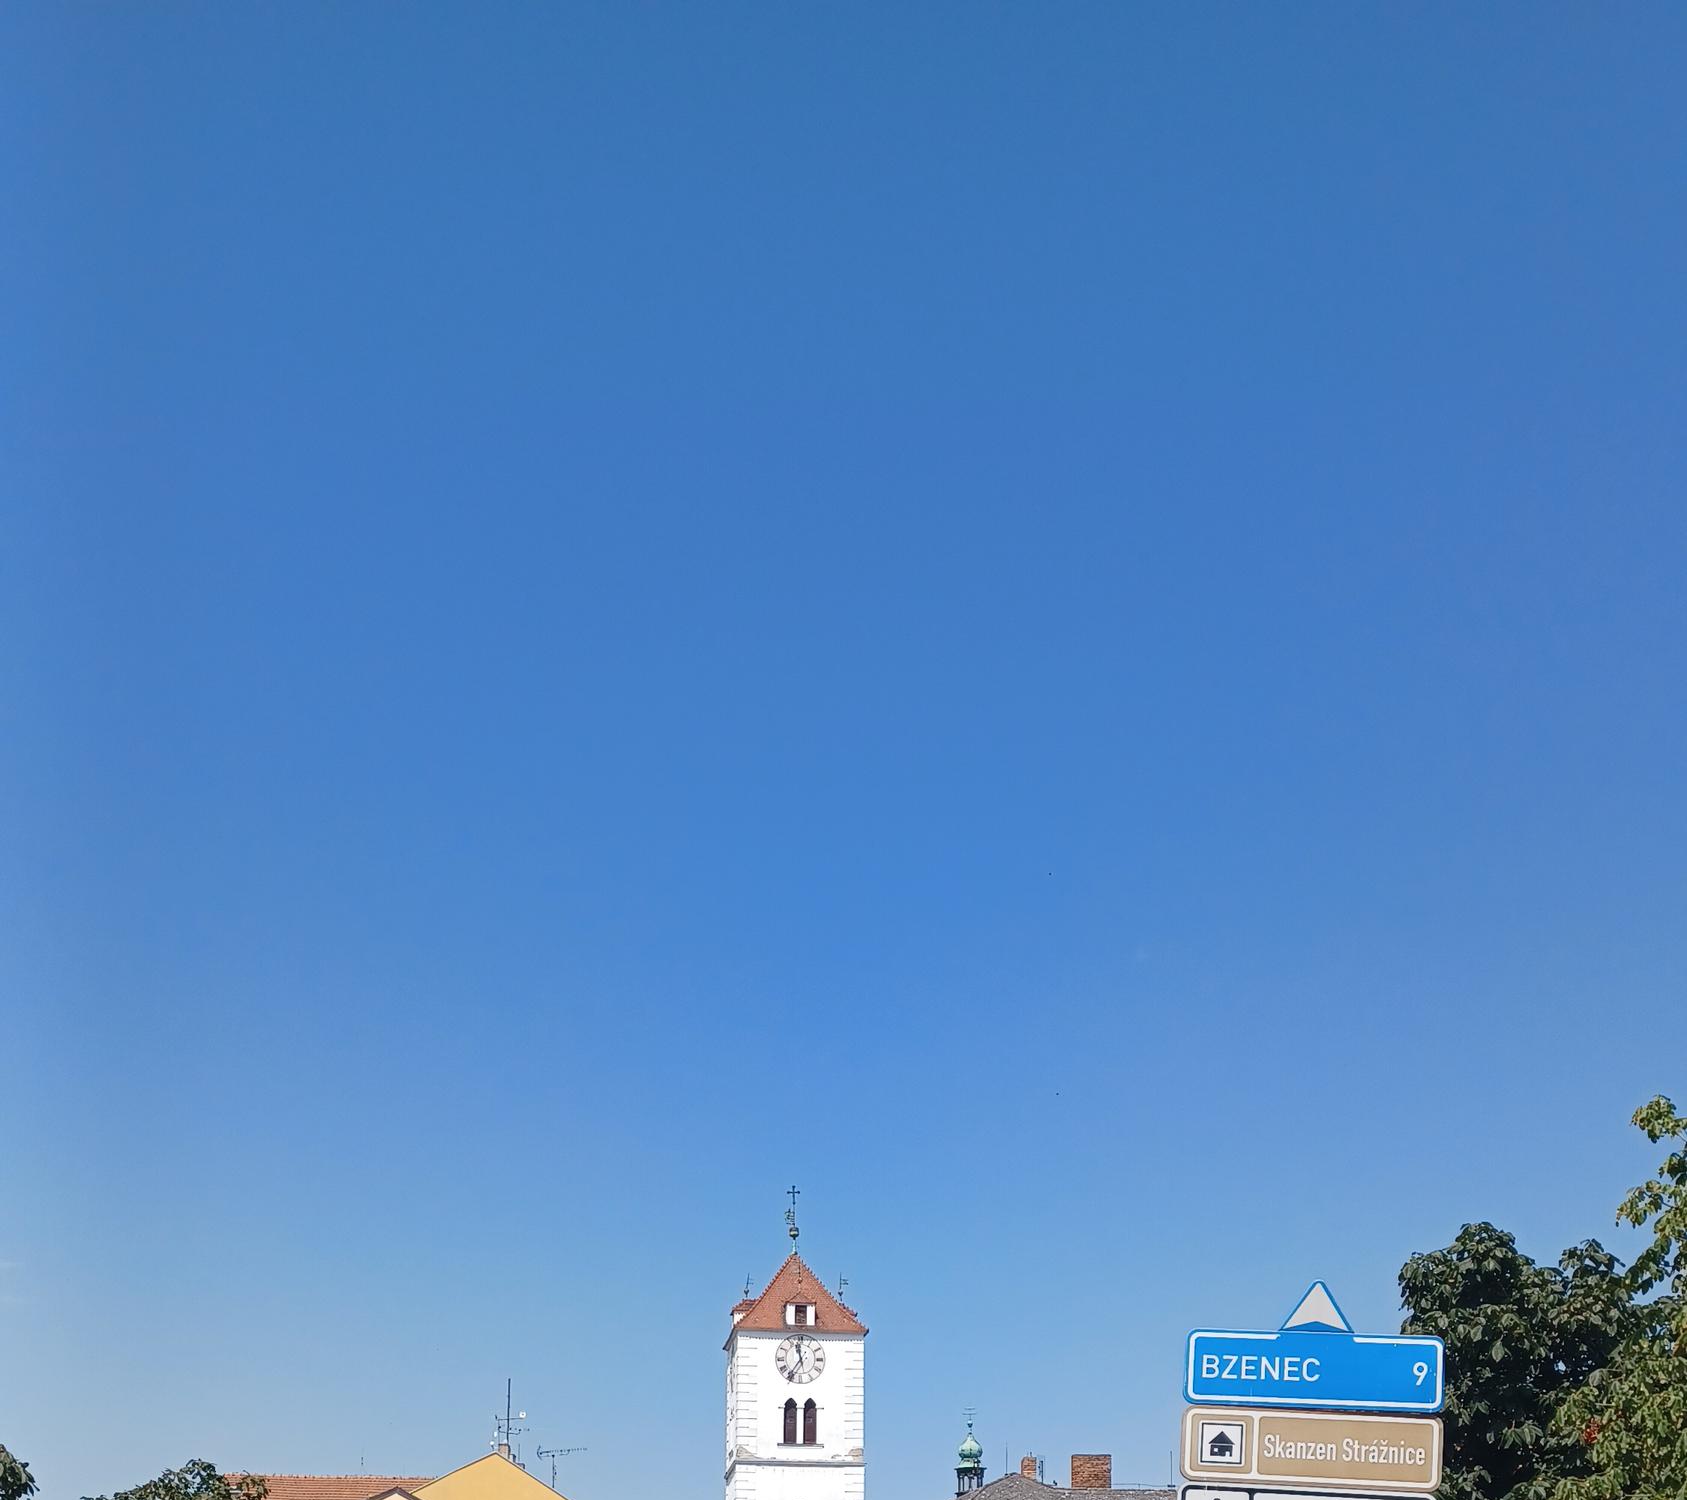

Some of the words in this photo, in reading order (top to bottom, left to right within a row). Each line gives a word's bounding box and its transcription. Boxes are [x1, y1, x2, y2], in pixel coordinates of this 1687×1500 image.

[1201, 1353, 1321, 1382] BZENEC
[1412, 1361, 1429, 1386] 9
[1263, 1433, 1337, 1462] Skanzen
[1342, 1437, 1427, 1466] Strážnice
